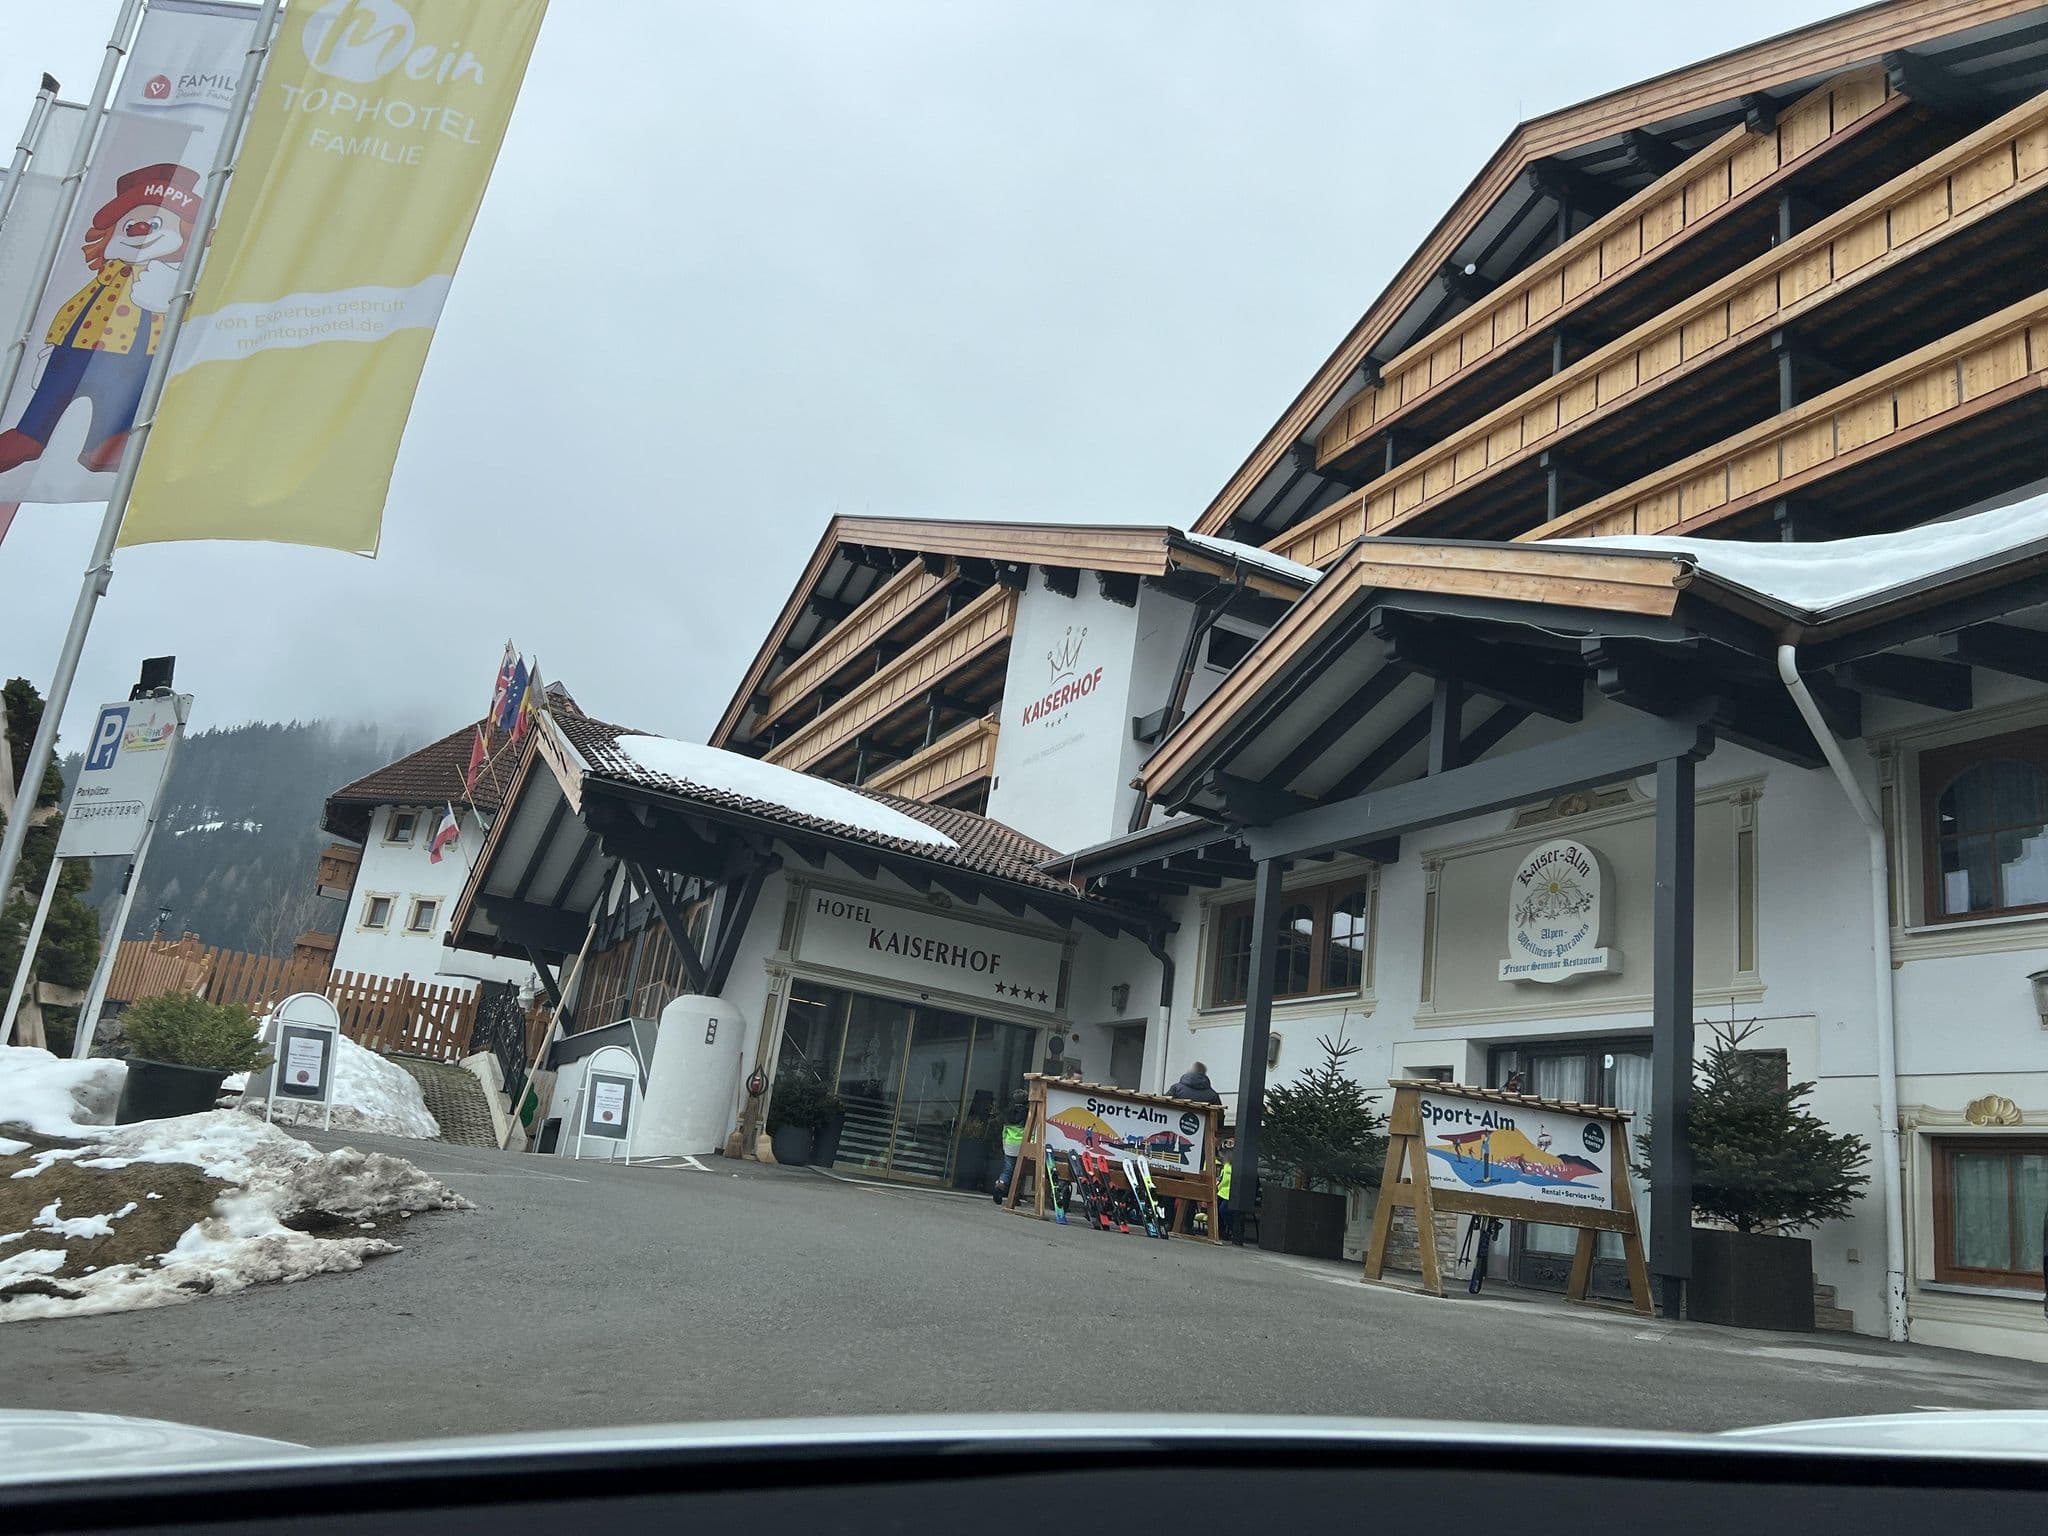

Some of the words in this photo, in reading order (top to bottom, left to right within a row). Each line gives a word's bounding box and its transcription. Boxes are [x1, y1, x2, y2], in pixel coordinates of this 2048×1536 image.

[311, 0, 485, 86] Mein
[177, 74, 240, 91] FAMIL
[280, 83, 482, 145] TOPHOTEL
[308, 127, 424, 165] FAMILIE
[144, 183, 193, 207] HAPPY
[215, 317, 247, 329] von
[256, 304, 332, 328] Experten
[237, 317, 385, 351] meintophotel.de
[1022, 667, 1103, 727] KAISERHOF
[92, 714, 123, 764] P
[103, 747, 114, 767] 1
[1517, 846, 1591, 888] Kaiser-Alm
[816, 897, 872, 924] HOTEL
[1541, 928, 1568, 940] Alpen-
[868, 927, 1001, 975] KAISERHOF
[1503, 963, 1530, 976] Friseur
[1530, 961, 1562, 971] Seminar
[1562, 955, 1603, 968] Restaurant
[1086, 1098, 1168, 1125] Sport-Alm
[1420, 1099, 1515, 1131] Sport-Alm
[1541, 1187, 1560, 1197] Rental
[1564, 1190, 1587, 1200] Service
[1590, 1192, 1606, 1204] Shop
